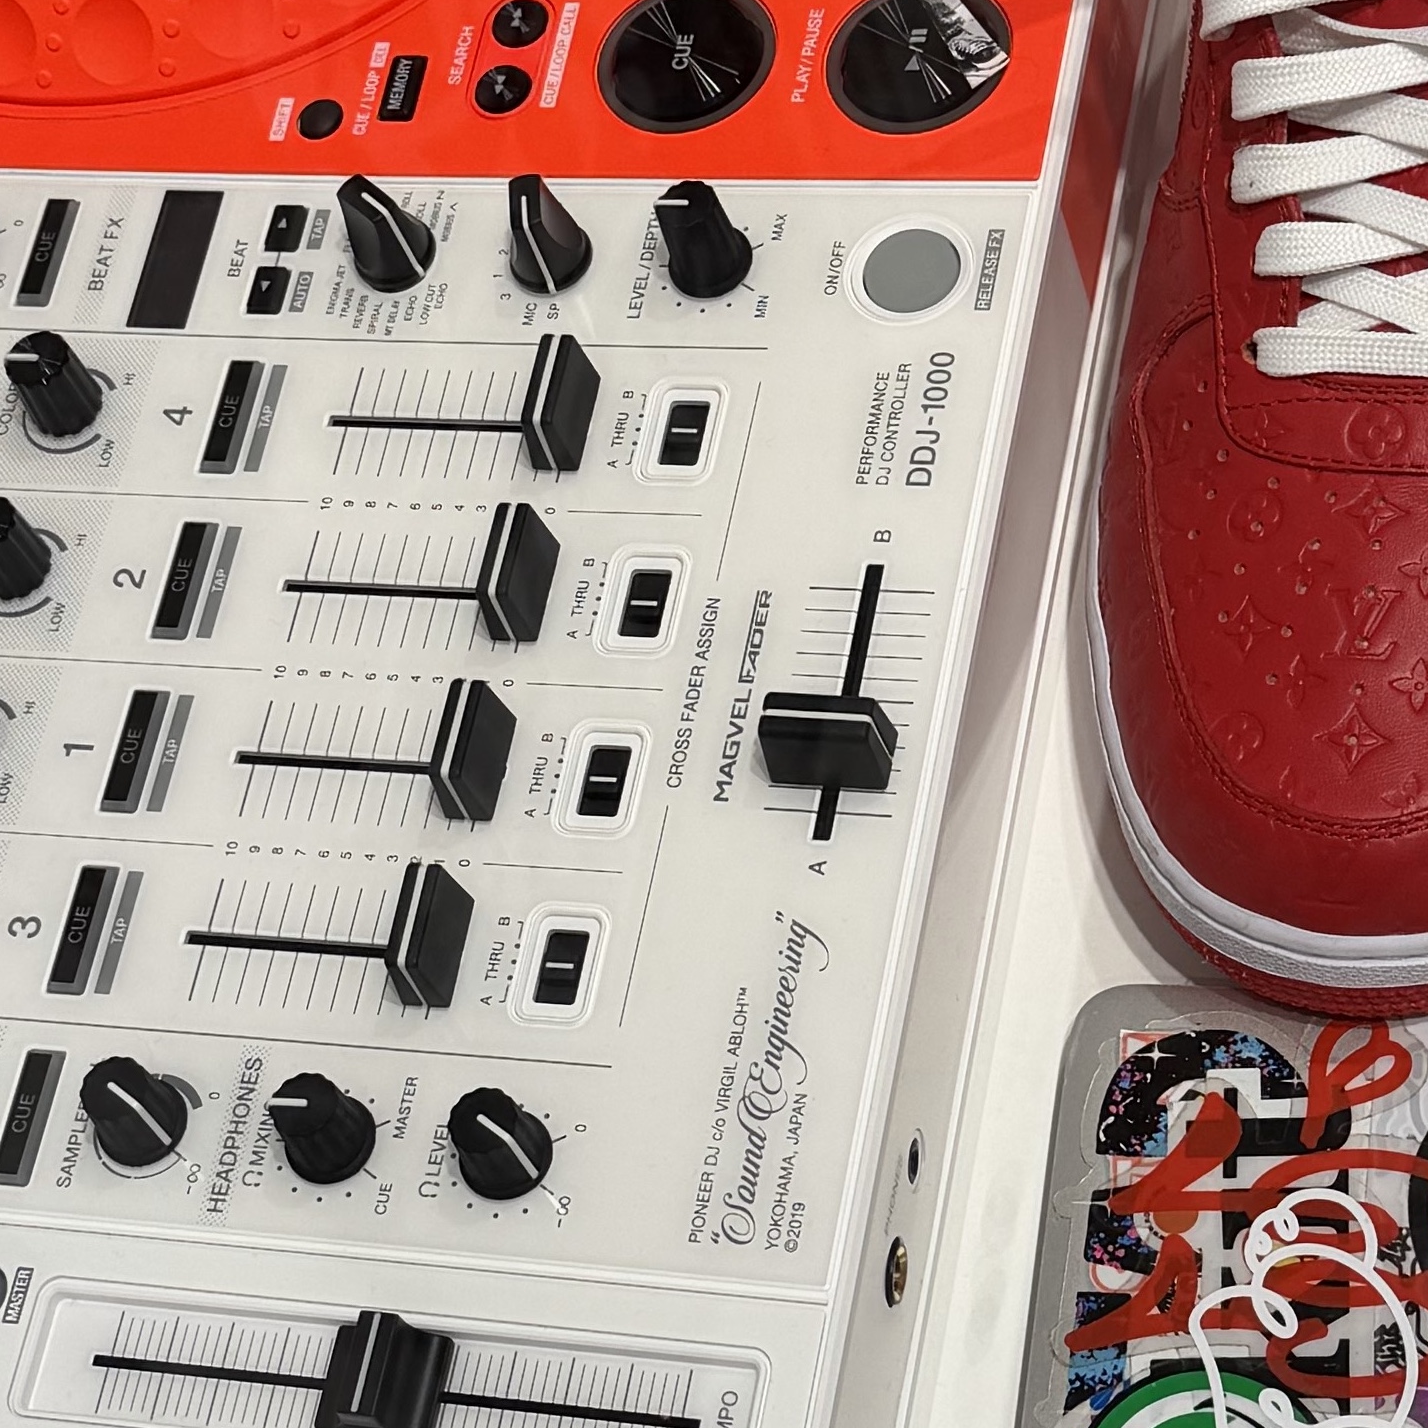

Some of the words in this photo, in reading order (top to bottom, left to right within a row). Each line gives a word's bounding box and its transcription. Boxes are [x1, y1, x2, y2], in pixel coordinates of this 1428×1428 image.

[448, 25, 474, 85] SEARCH
[671, 34, 695, 70] CUE
[789, 8, 826, 103] PLAY/PAUSE
[387, 59, 413, 110] MEMORY
[273, 101, 292, 137] SHIFT
[99, 216, 125, 240] FX
[310, 217, 325, 241] TAP
[771, 213, 788, 242] MAX
[987, 230, 1003, 250] FX
[35, 231, 56, 263] CUE
[227, 239, 249, 279] BEAT
[87, 244, 117, 292] BEAT
[823, 240, 846, 296] ON/OFF
[978, 252, 1000, 310] RELEASE
[292, 274, 311, 309] AUTO
[754, 294, 769, 319] MIN
[522, 302, 537, 326] MIC
[163, 406, 193, 426] 4
[218, 395, 240, 429] CUE
[856, 371, 891, 486] PERFORMANCE
[878, 363, 912, 463] CONTROLLER
[905, 351, 955, 487] DDJ-1000
[876, 465, 892, 486] DJ
[113, 568, 147, 589] 2
[171, 558, 193, 593] CUE
[211, 568, 227, 594] TAP
[570, 579, 591, 617] THRU
[692, 597, 721, 661] ASSIGN
[681, 665, 707, 722] FADER
[712, 688, 752, 803] MAGVEL
[737, 589, 773, 683] FADER
[63, 741, 95, 758] 1
[120, 728, 143, 764] CUE
[666, 727, 693, 789] CROSS
[7, 915, 42, 939] 3
[67, 905, 92, 944] CUE
[110, 917, 127, 945] TAP
[484, 940, 506, 981] THRU
[714, 1061, 739, 1113] VIRGIL
[392, 1076, 419, 1139] MASTER
[206, 1056, 263, 1214] HEADPHONES
[709, 1117, 727, 1142] c/o
[705, 1146, 722, 1166] DJ
[764, 1150, 799, 1251] YOKOHAMA,
[786, 1093, 809, 1145] JAPAN
[374, 1182, 393, 1216] CUE
[688, 1172, 715, 1244] PIONEER
[784, 1201, 806, 1253] ©2019
[3, 1269, 30, 1321] MASTER
